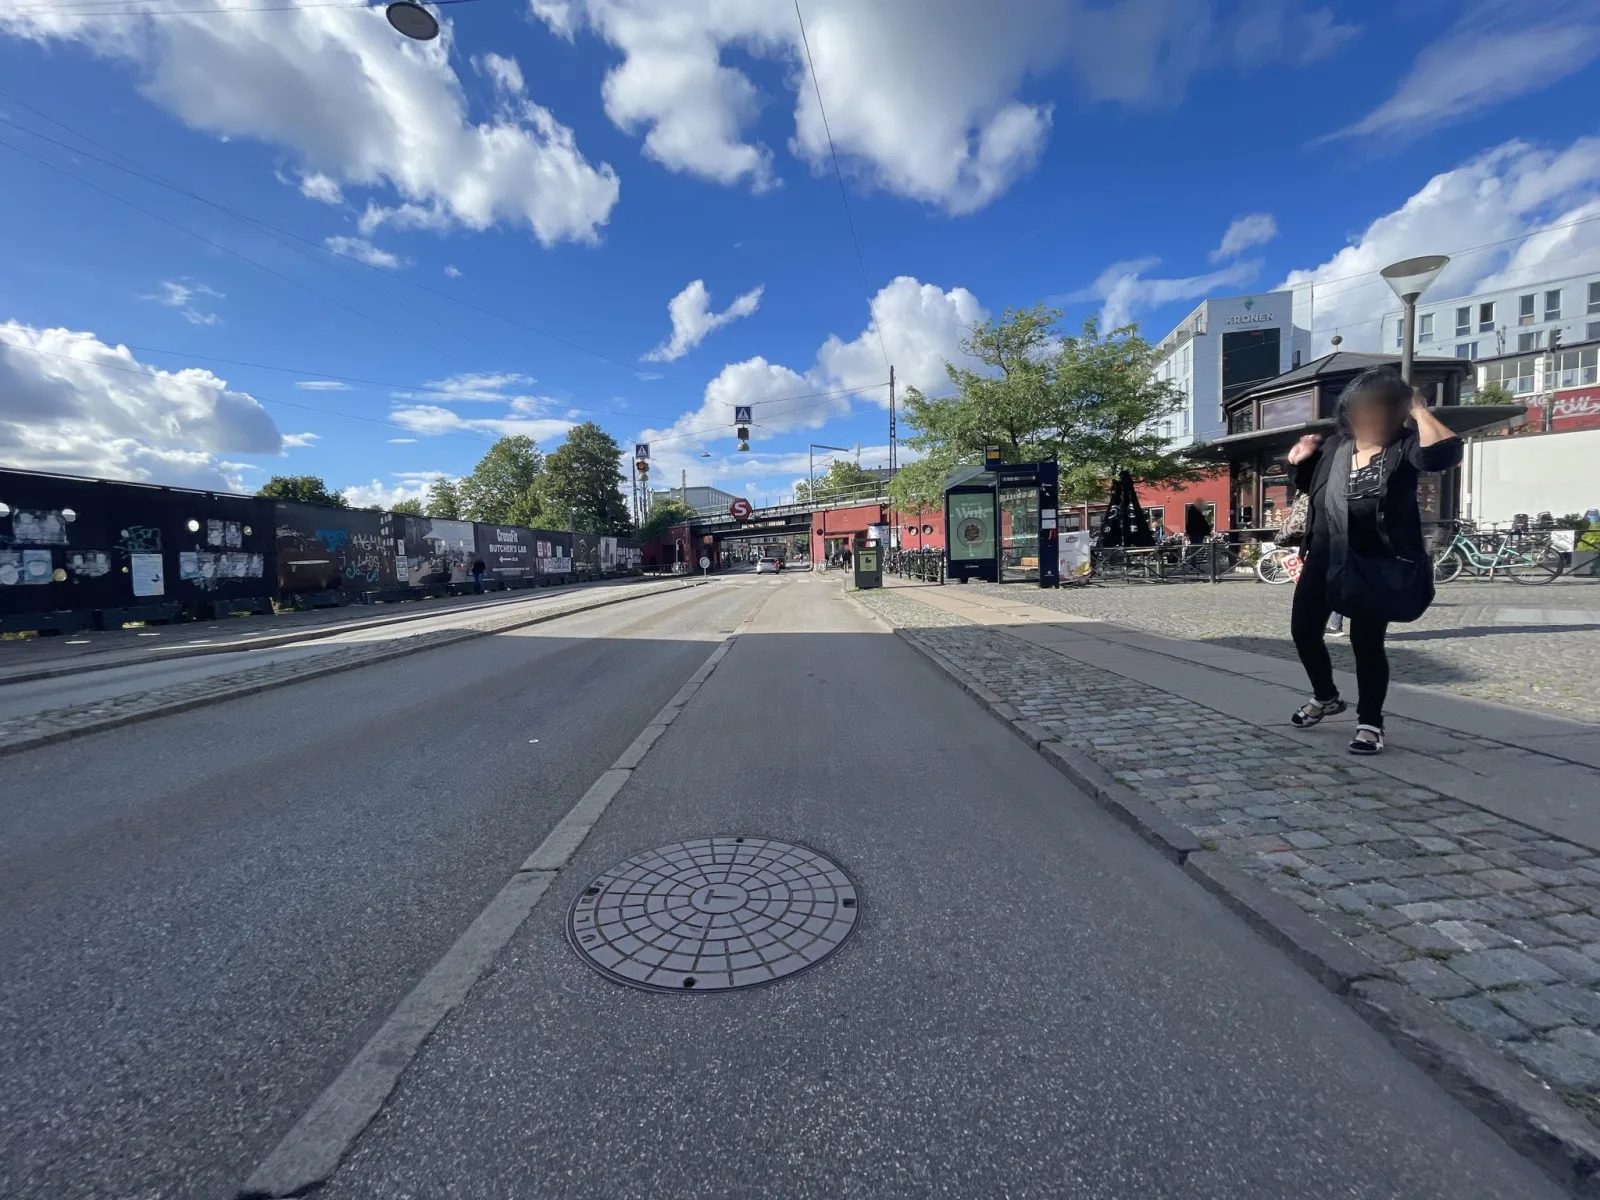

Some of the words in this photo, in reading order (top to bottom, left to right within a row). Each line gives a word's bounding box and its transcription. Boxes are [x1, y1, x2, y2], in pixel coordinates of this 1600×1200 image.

[1224, 312, 1275, 326] KRONEN
[734, 501, 747, 516] S
[496, 528, 519, 543] CrossFit
[488, 544, 517, 553] BUTCHER'S
[517, 545, 528, 553] LAB
